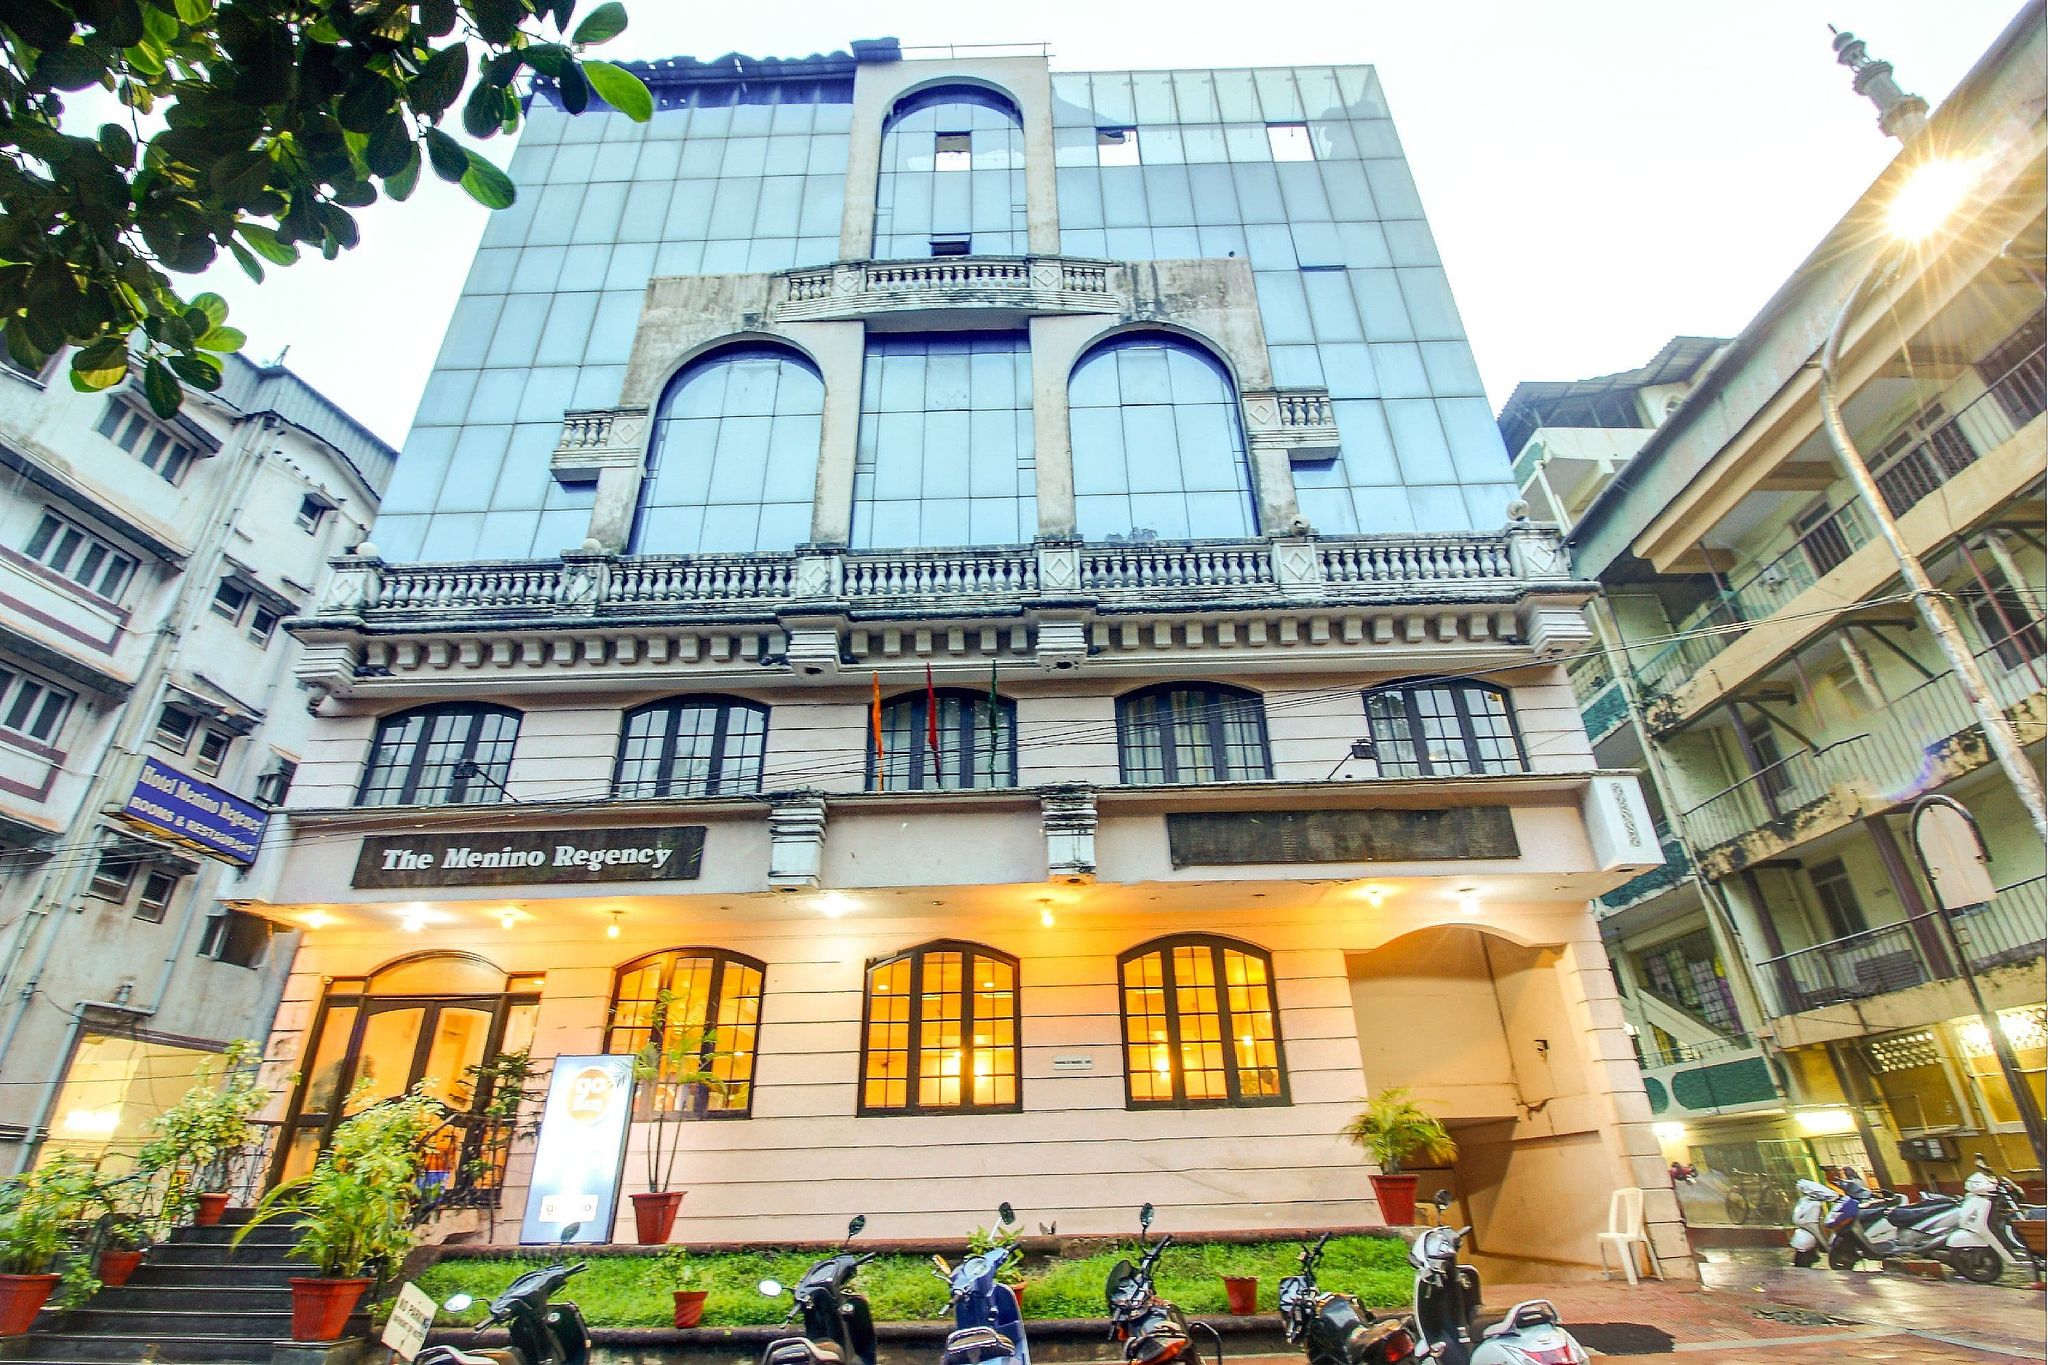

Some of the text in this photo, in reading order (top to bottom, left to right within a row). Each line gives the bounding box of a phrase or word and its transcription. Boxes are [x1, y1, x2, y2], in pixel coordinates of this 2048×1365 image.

[128, 796, 176, 822] ROOMS
[175, 815, 185, 827] &
[140, 765, 264, 836] Hotel Menino Regency
[382, 845, 674, 872] The Menino Regency
